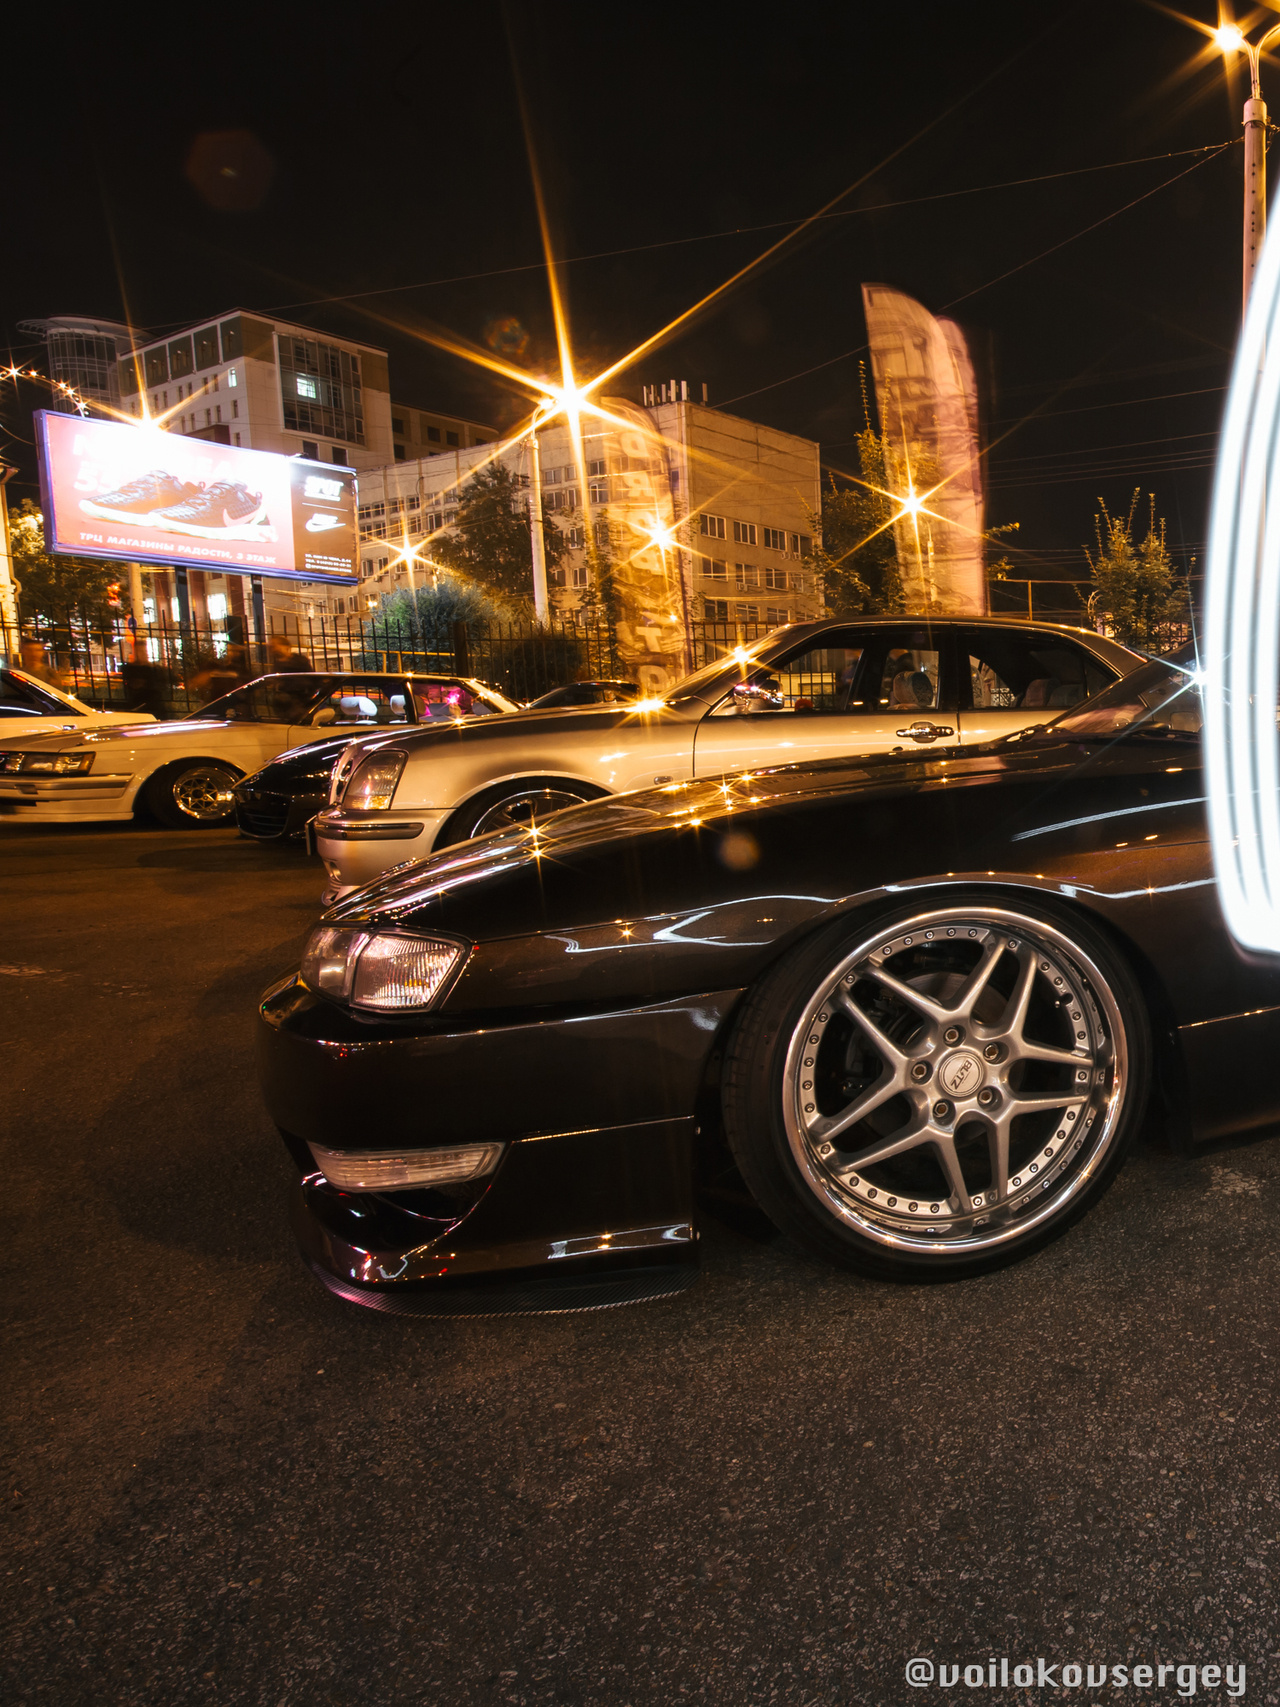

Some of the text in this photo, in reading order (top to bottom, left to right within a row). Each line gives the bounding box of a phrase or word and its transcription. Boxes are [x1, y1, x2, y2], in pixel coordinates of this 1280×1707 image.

[79, 532, 103, 543] ТРЦ
[107, 536, 174, 551] МАГАЗИНЫ
[178, 545, 233, 559] РАДОСТИ,
[246, 554, 276, 564] ЭТАЖ
